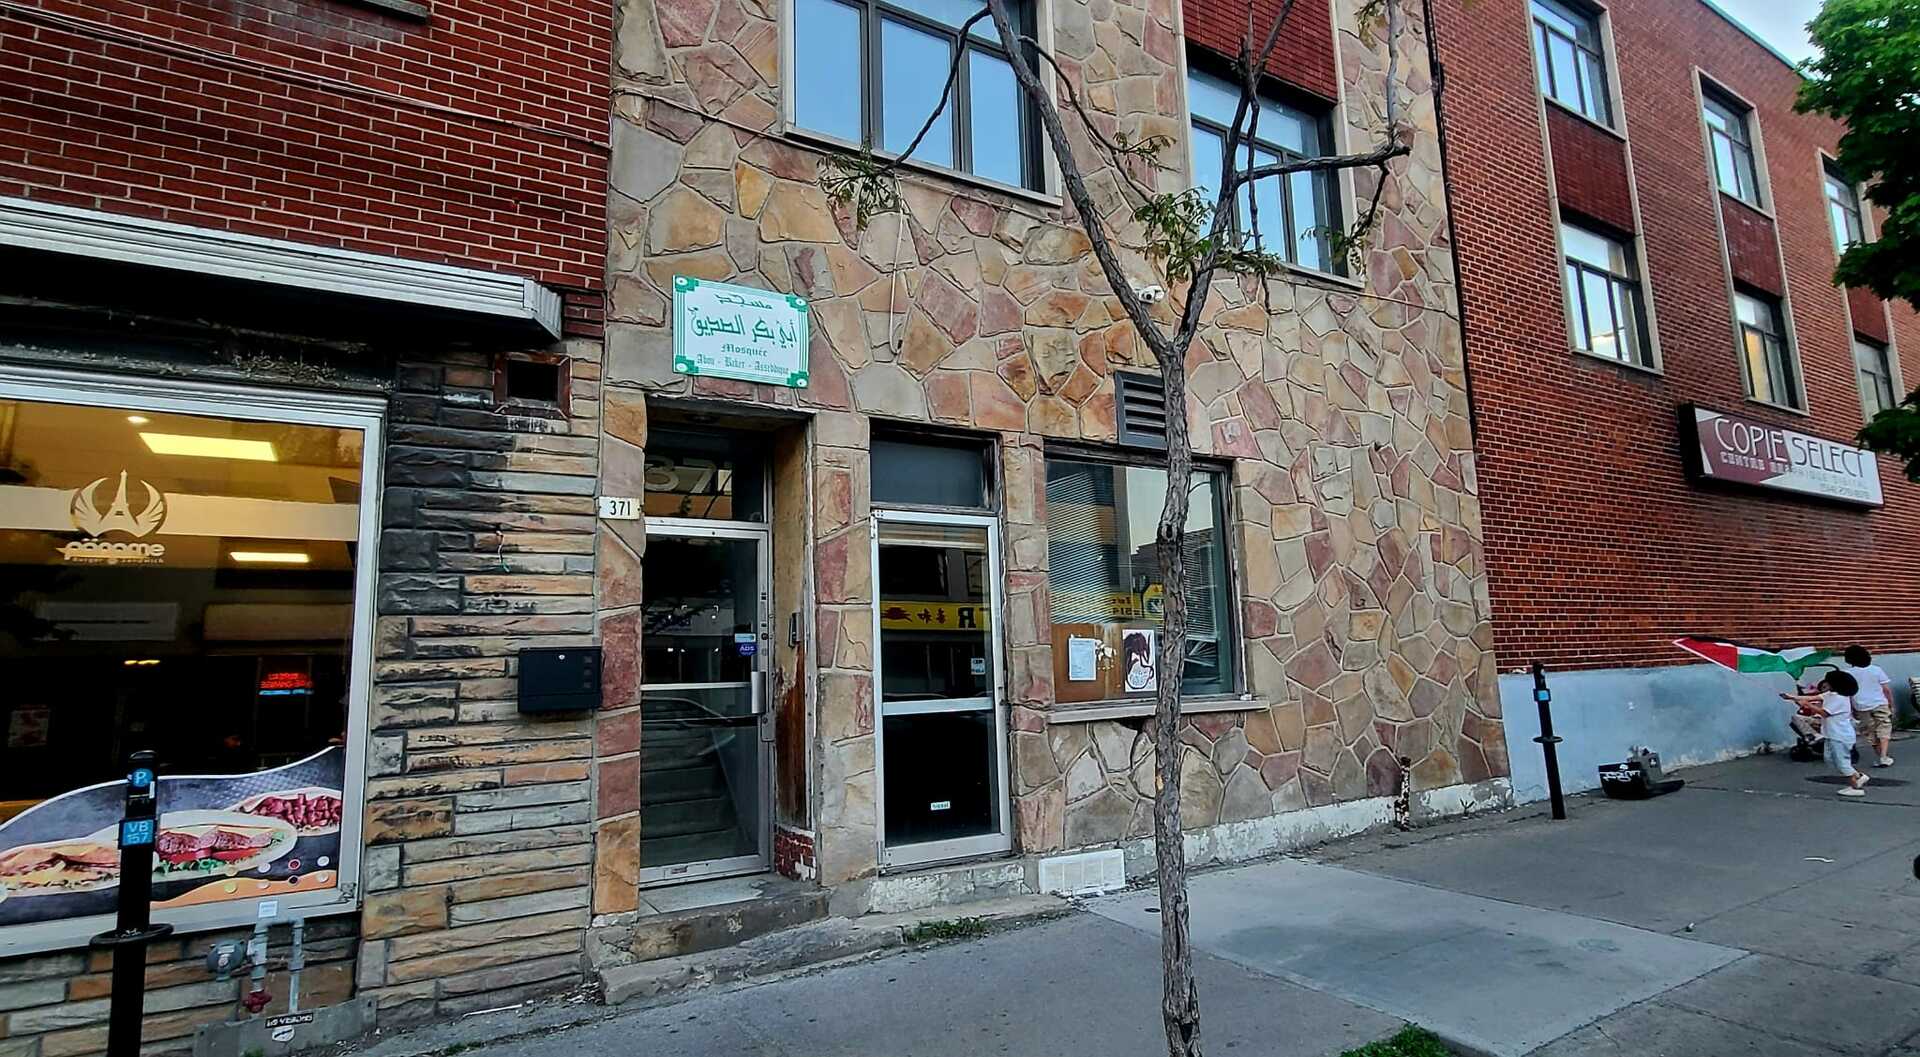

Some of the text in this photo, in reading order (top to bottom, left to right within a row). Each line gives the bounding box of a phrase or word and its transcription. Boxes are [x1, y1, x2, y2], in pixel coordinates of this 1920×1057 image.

[1714, 418, 1788, 462] COPIE
[1791, 437, 1864, 478] SELECT
[610, 500, 631, 516] 371
[135, 771, 147, 784] P
[128, 821, 148, 832] VB
[127, 832, 149, 844] 157
